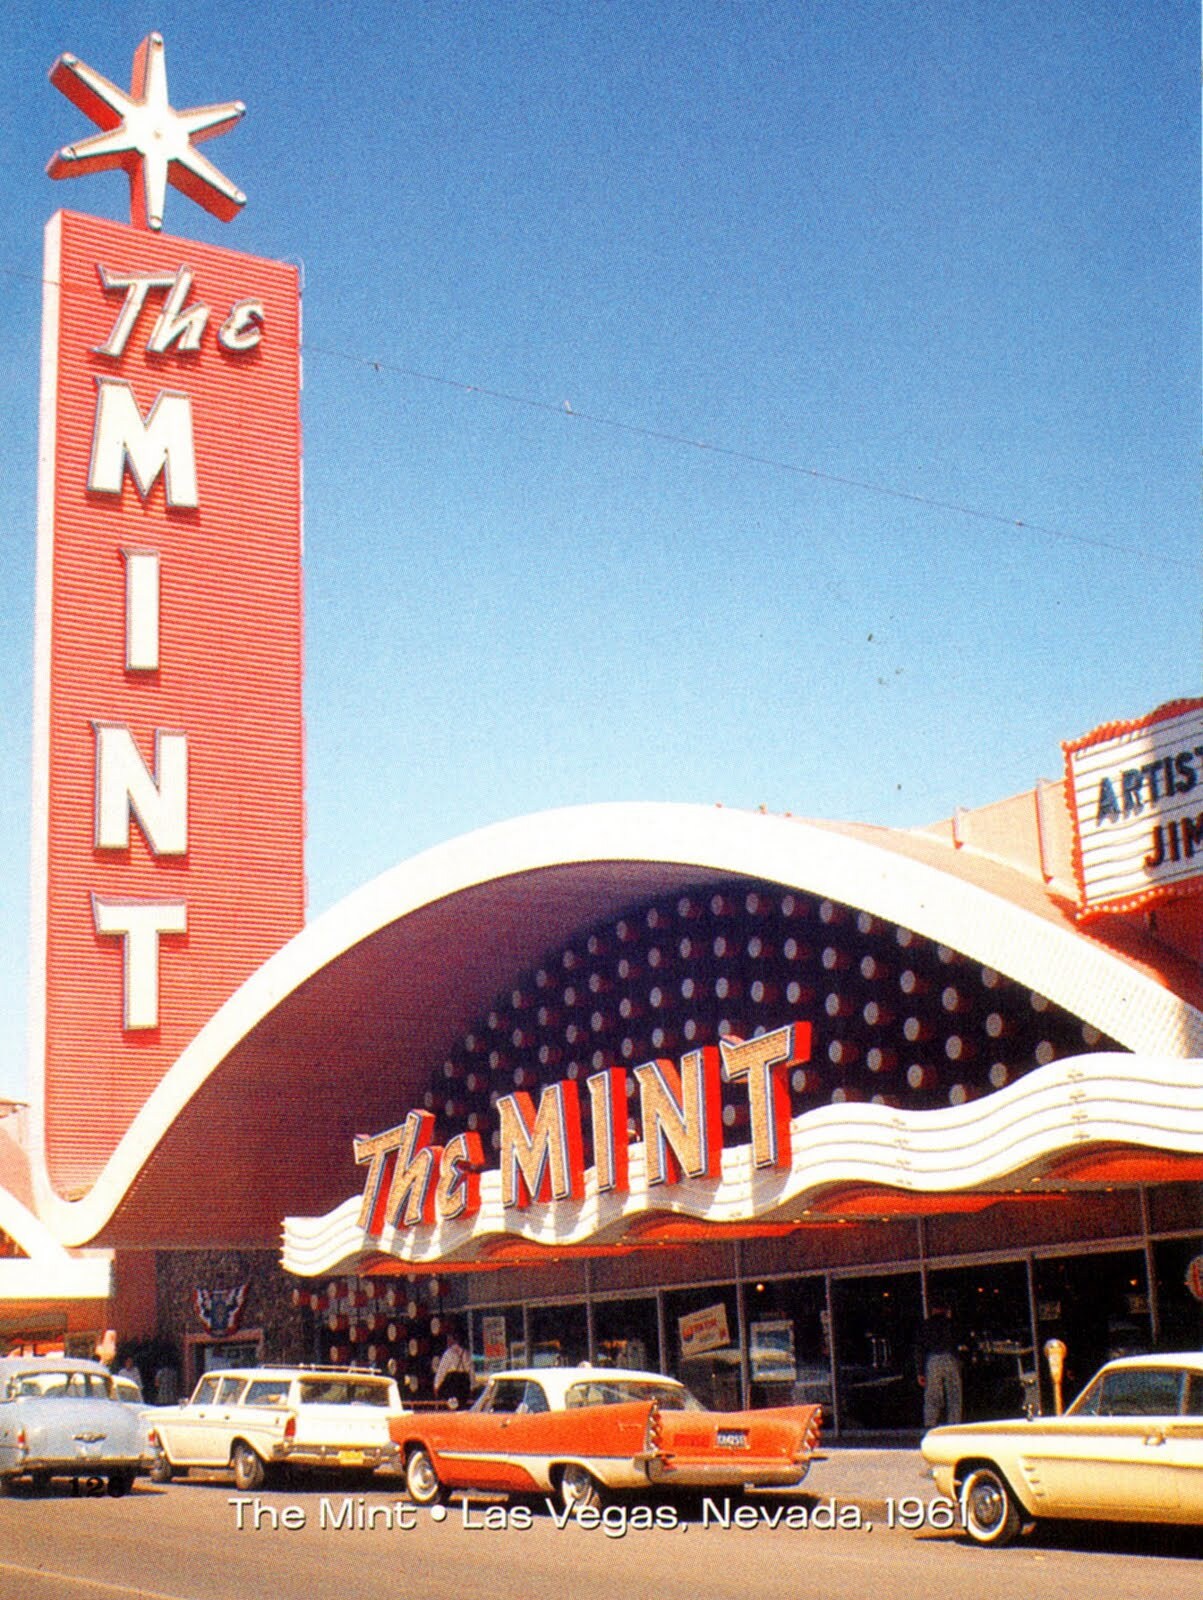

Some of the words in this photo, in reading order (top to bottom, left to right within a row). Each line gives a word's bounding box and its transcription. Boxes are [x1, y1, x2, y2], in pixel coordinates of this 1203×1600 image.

[91, 263, 266, 356] The
[87, 376, 199, 1031] MINT
[1096, 746, 1203, 827] ARTIS
[353, 1110, 480, 1235] The
[497, 1022, 808, 1208] MINT
